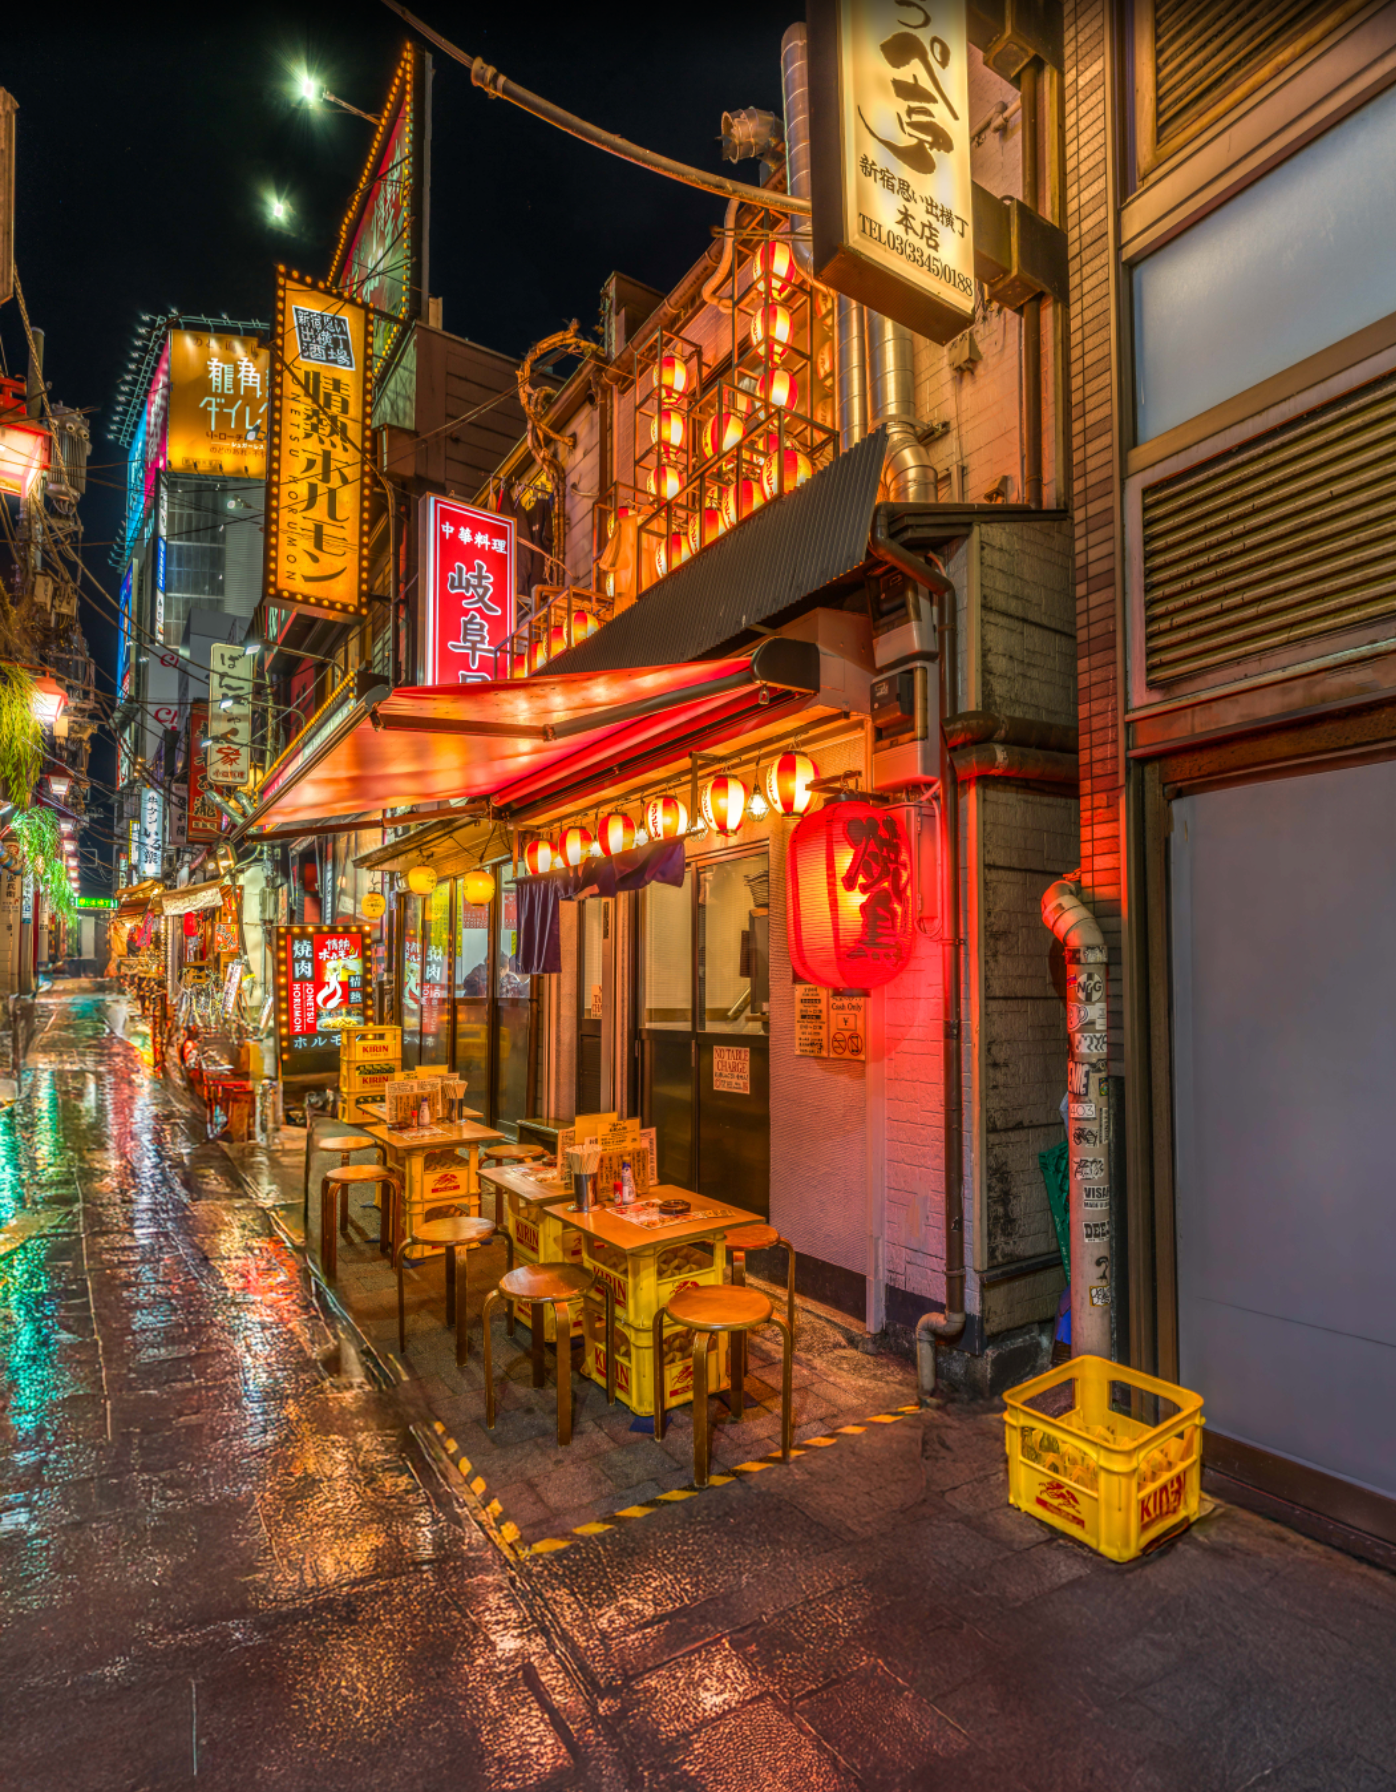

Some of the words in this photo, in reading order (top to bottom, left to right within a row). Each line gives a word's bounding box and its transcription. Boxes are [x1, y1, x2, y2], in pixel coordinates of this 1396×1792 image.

[859, 153, 970, 239] 新宿思い出横丁
[895, 204, 940, 253] 本店
[207, 356, 269, 398] 龍角
[299, 370, 352, 583] 情熱ホルモン
[441, 520, 508, 555] 中華料理
[292, 939, 313, 979] 焼肉
[292, 983, 302, 1033] HORUMON
[306, 983, 316, 1024] JONETSU
[831, 1003, 846, 1011] Cash
[848, 1003, 862, 1012] Only
[362, 1045, 389, 1054] KIRIN
[715, 1048, 725, 1060] NO
[726, 1049, 749, 1062] TABLE
[717, 1060, 747, 1074] CHARGE
[362, 1075, 389, 1085] KIRIN
[515, 1219, 539, 1249] KIRIN
[594, 1346, 630, 1388] KIIN
